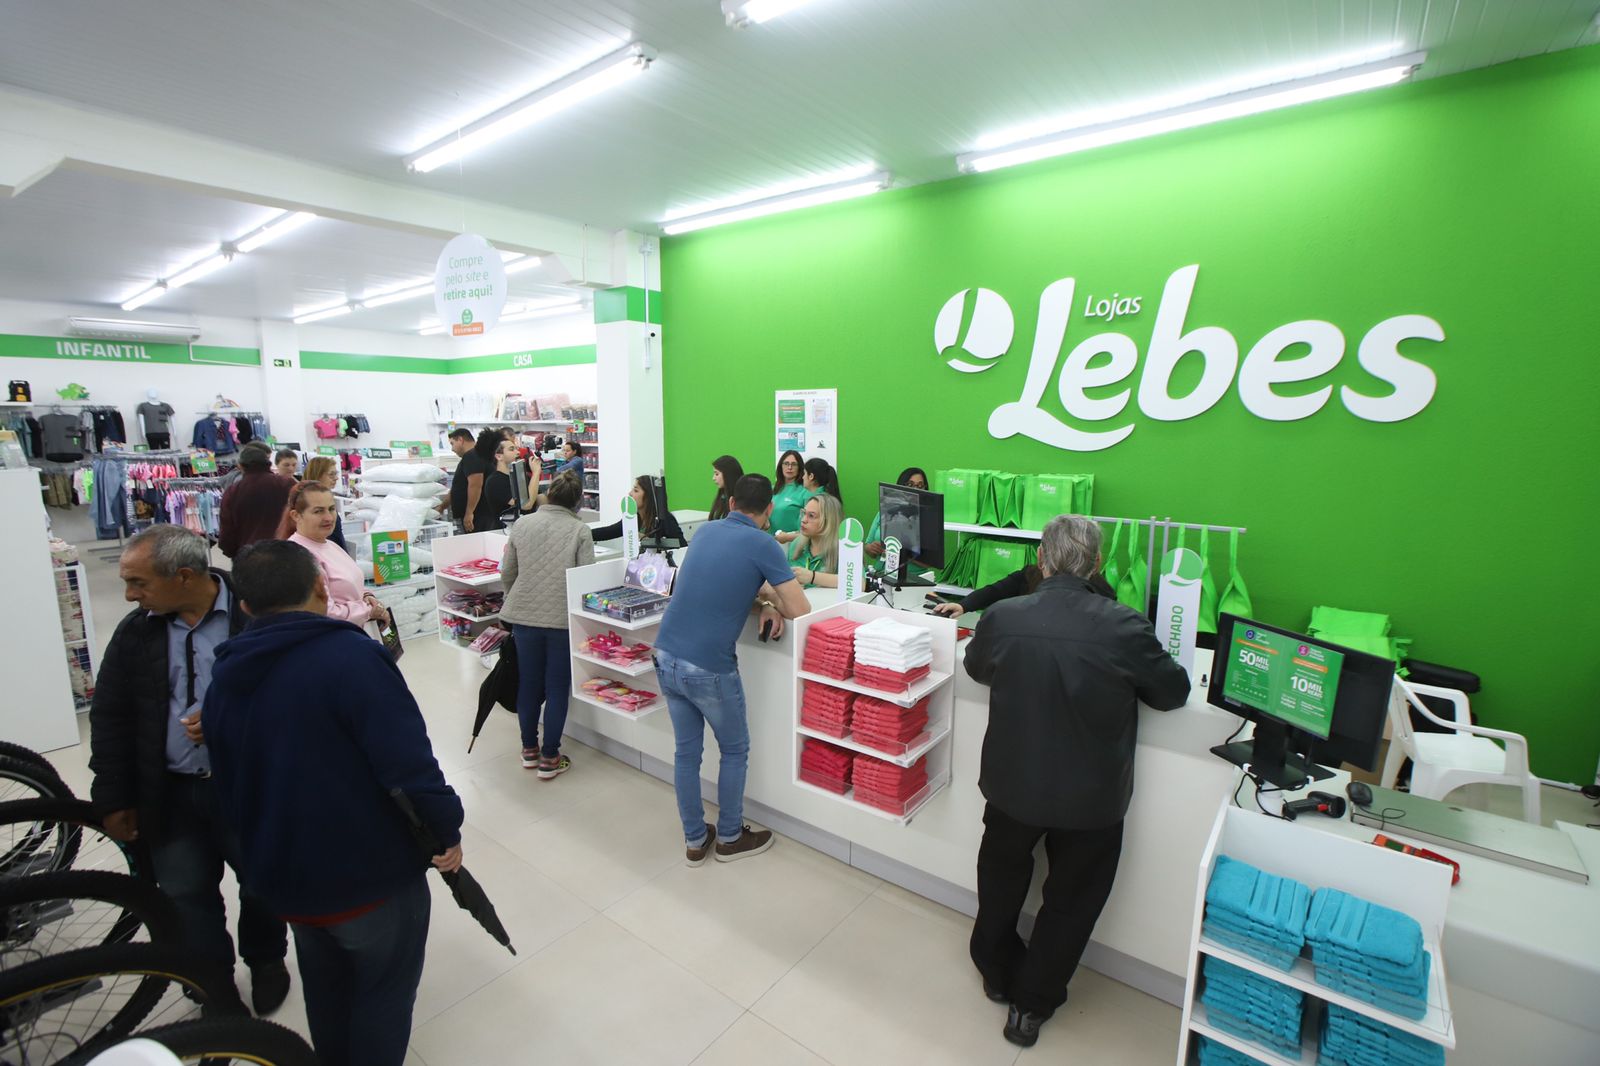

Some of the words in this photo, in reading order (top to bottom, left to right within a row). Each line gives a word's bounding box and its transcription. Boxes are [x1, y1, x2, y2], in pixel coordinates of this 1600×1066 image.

[449, 255, 484, 269] Compre
[445, 273, 463, 288] pelo
[466, 271, 482, 282] site
[483, 271, 489, 280] e
[443, 287, 466, 301] retire
[468, 284, 493, 301] aqui!
[1084, 293, 1142, 321] Lojas
[56, 341, 151, 360] INFANTIL
[988, 264, 1446, 452] Lebes
[513, 354, 533, 367] CASA
[1239, 649, 1256, 666] 50
[1255, 655, 1269, 666] MIL
[1291, 676, 1308, 693] 10
[1308, 682, 1323, 693] MIL
